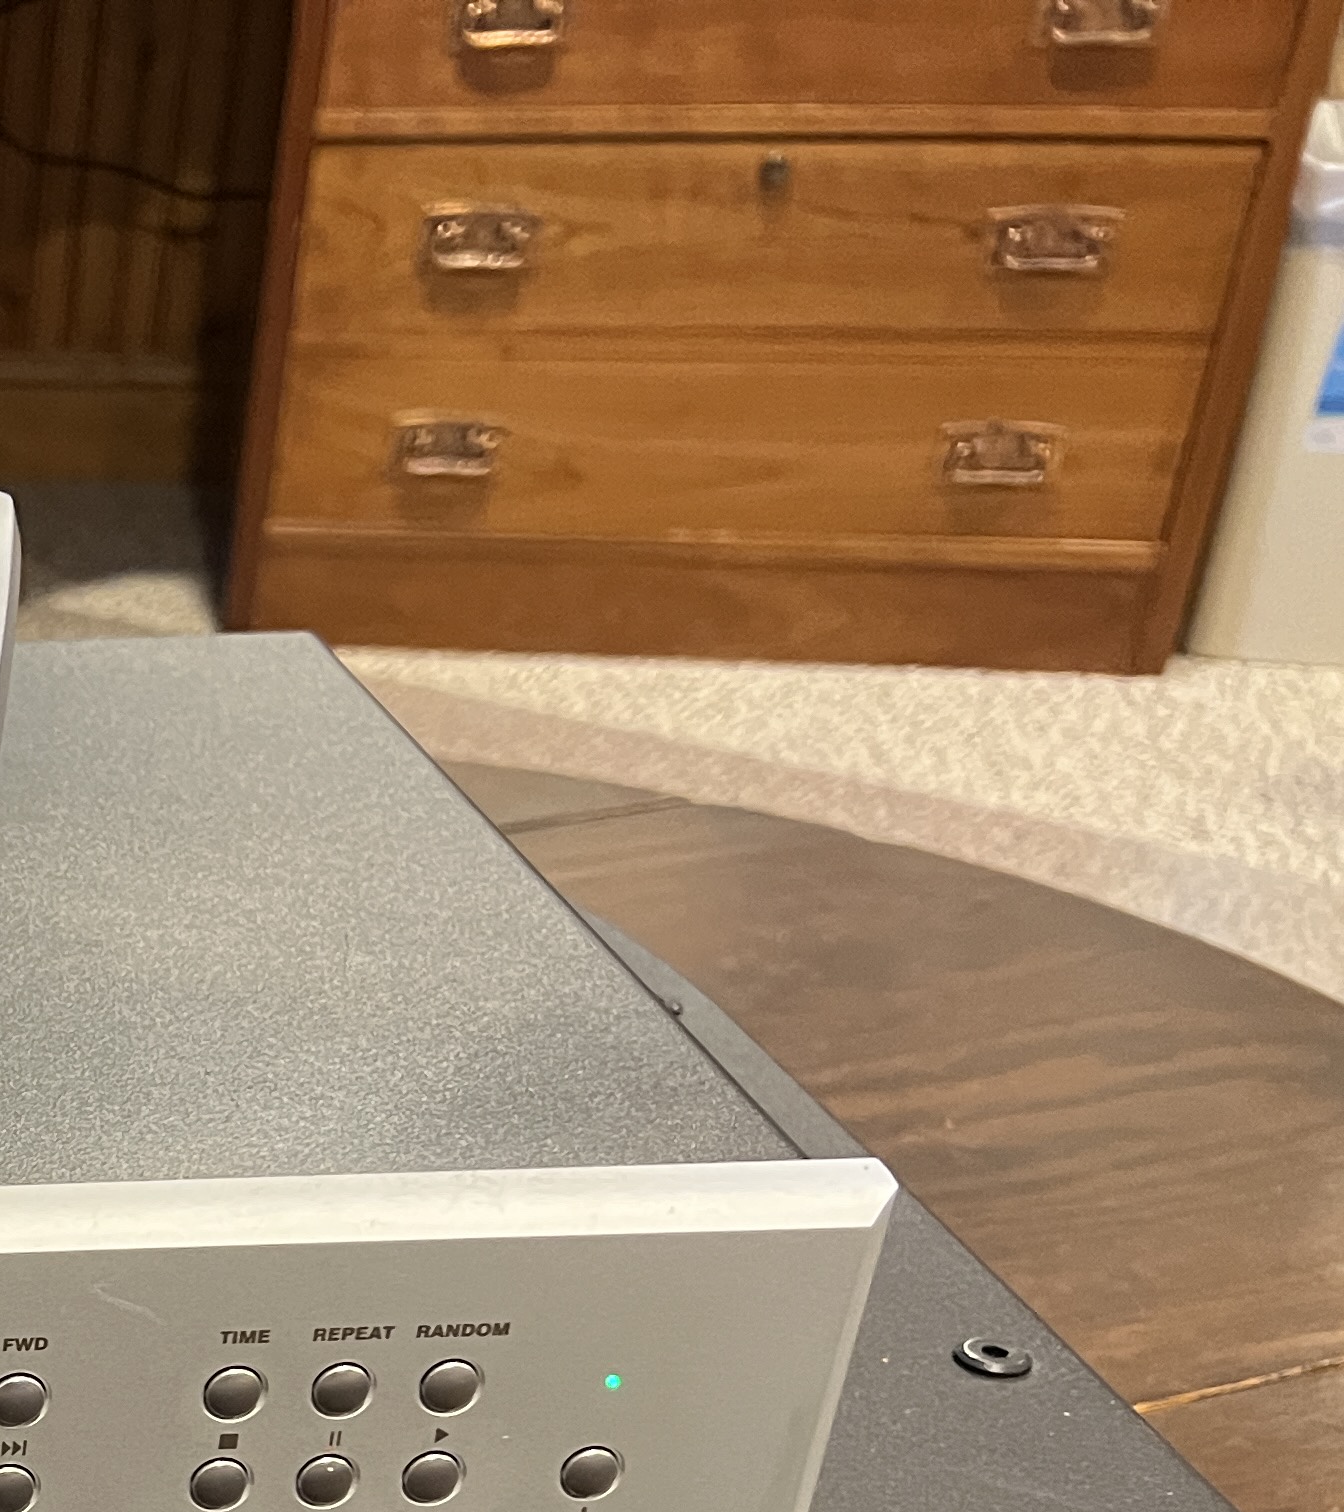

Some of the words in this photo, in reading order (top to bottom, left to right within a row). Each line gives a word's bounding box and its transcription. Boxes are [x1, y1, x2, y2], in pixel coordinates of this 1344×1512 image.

[220, 1329, 271, 1344] TIME
[312, 1326, 396, 1342] REPEAT
[416, 1322, 511, 1339] RANDOM
[2, 1337, 49, 1351] FWD
